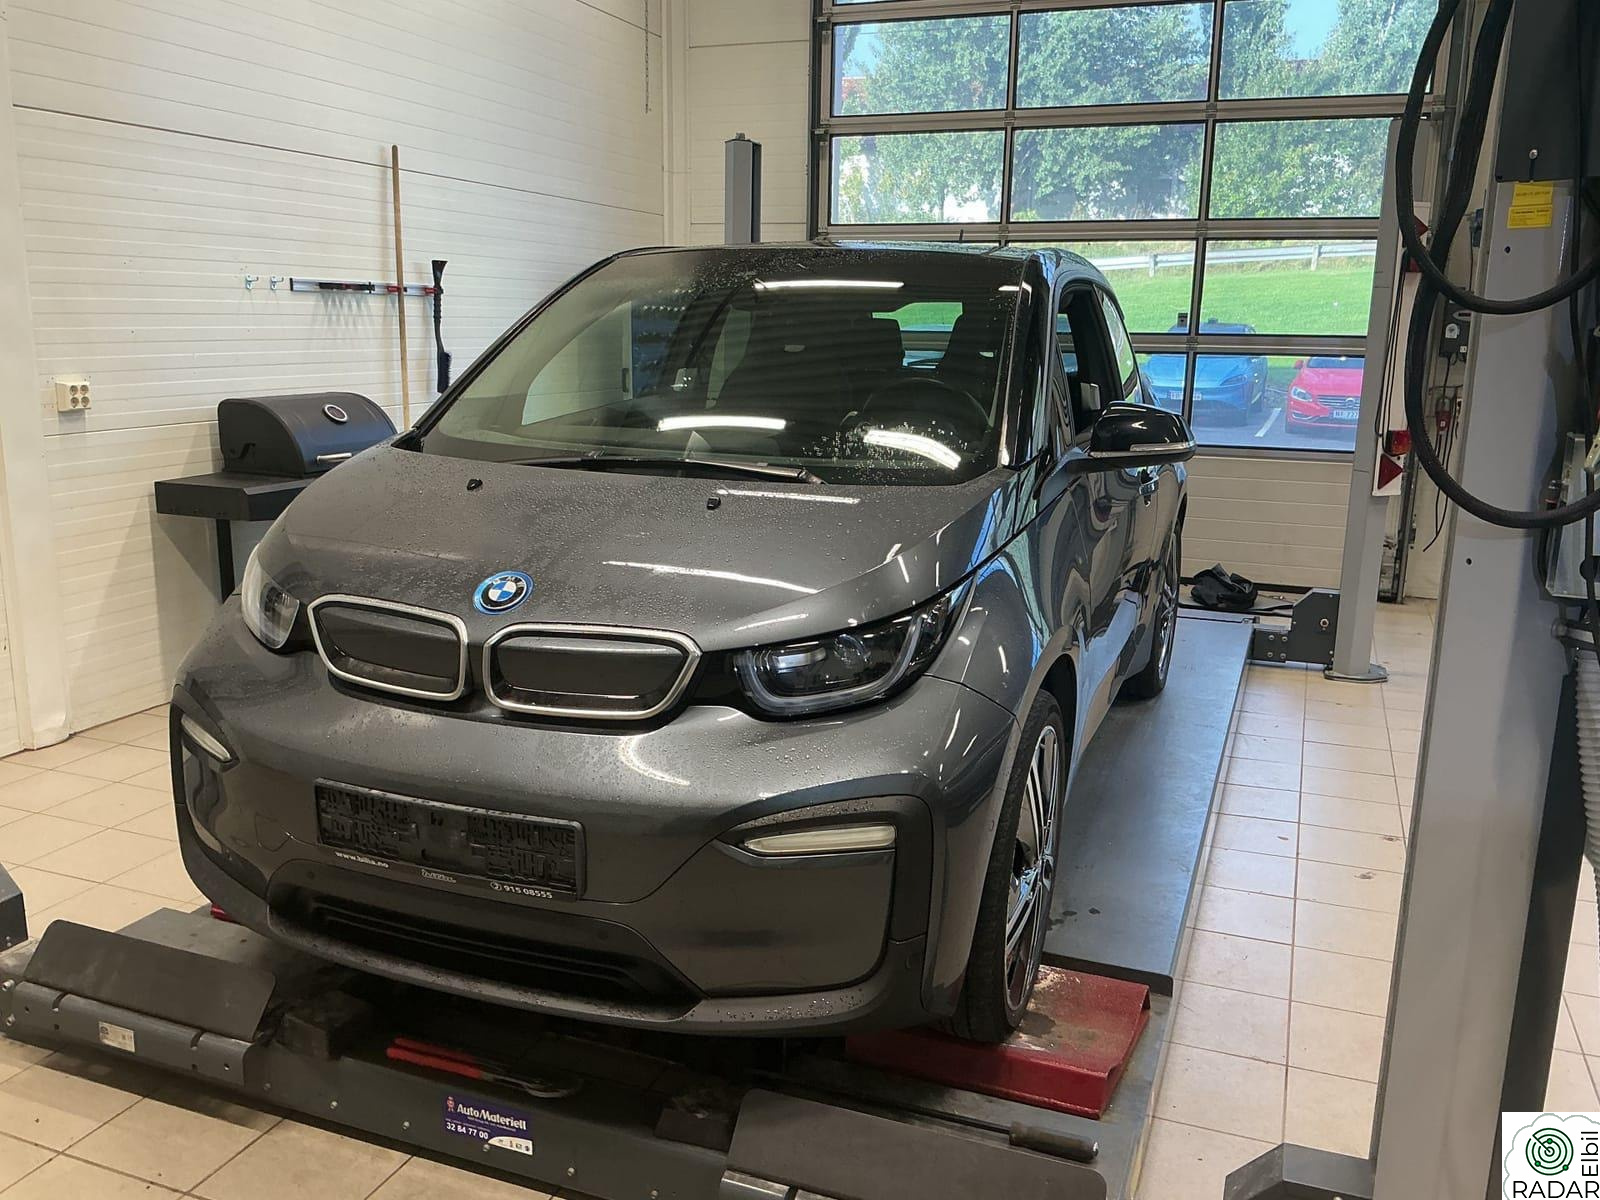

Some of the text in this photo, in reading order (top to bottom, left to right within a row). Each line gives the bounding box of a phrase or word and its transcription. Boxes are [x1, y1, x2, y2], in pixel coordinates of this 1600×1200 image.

[503, 885, 553, 899] 915 08555
[457, 1103, 527, 1131] AutoMateriell
[446, 1122, 456, 1131] 32
[457, 1125, 467, 1134] 84
[468, 1127, 478, 1137] 77
[479, 1131, 489, 1140] 00
